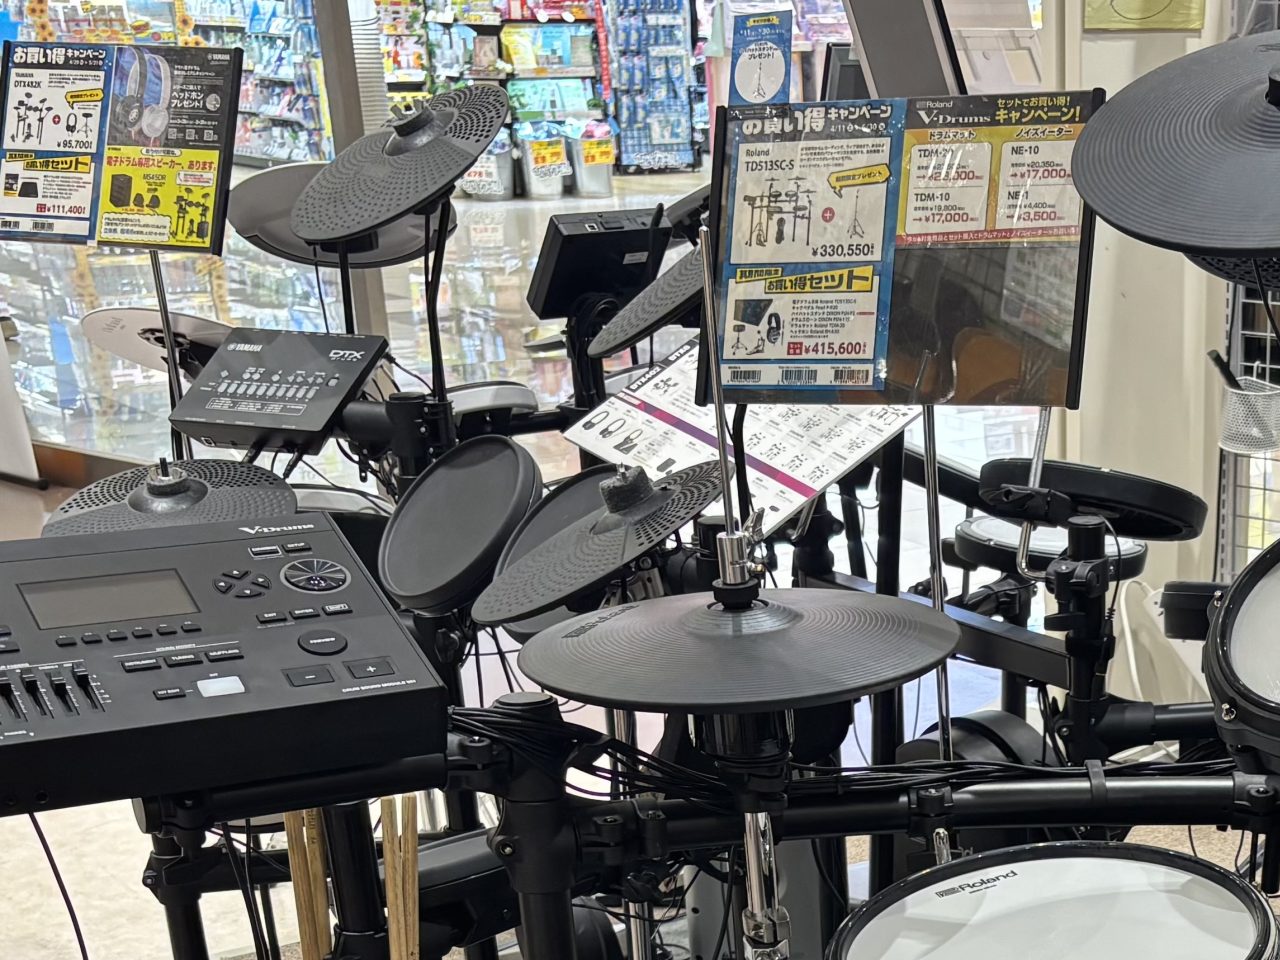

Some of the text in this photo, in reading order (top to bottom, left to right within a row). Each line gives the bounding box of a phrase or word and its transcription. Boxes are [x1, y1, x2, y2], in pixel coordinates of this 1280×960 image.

[14, 47, 106, 64] お買い得 キャンペーン
[997, 98, 1070, 108] セットでお買い得!
[828, 106, 892, 120] キャンペーン
[995, 106, 1080, 122] キャンペーン!
[929, 130, 976, 140] ドラムマット
[1016, 128, 1073, 138] ノイズイーター
[745, 149, 770, 157] Roland
[1011, 146, 1040, 155] NE-10
[745, 159, 795, 172] TD513SC-S
[1020, 169, 1067, 180] ¥17,000
[914, 193, 950, 202] TDM-10
[925, 213, 969, 223] ¥17,000
[812, 244, 870, 257] ¥330,550
[767, 270, 869, 291] お買い得セット
[236, 344, 262, 352] YAMAHA
[804, 342, 862, 355] ¥415,600
[328, 350, 365, 359] DTX
[959, 870, 1018, 892] Roland
